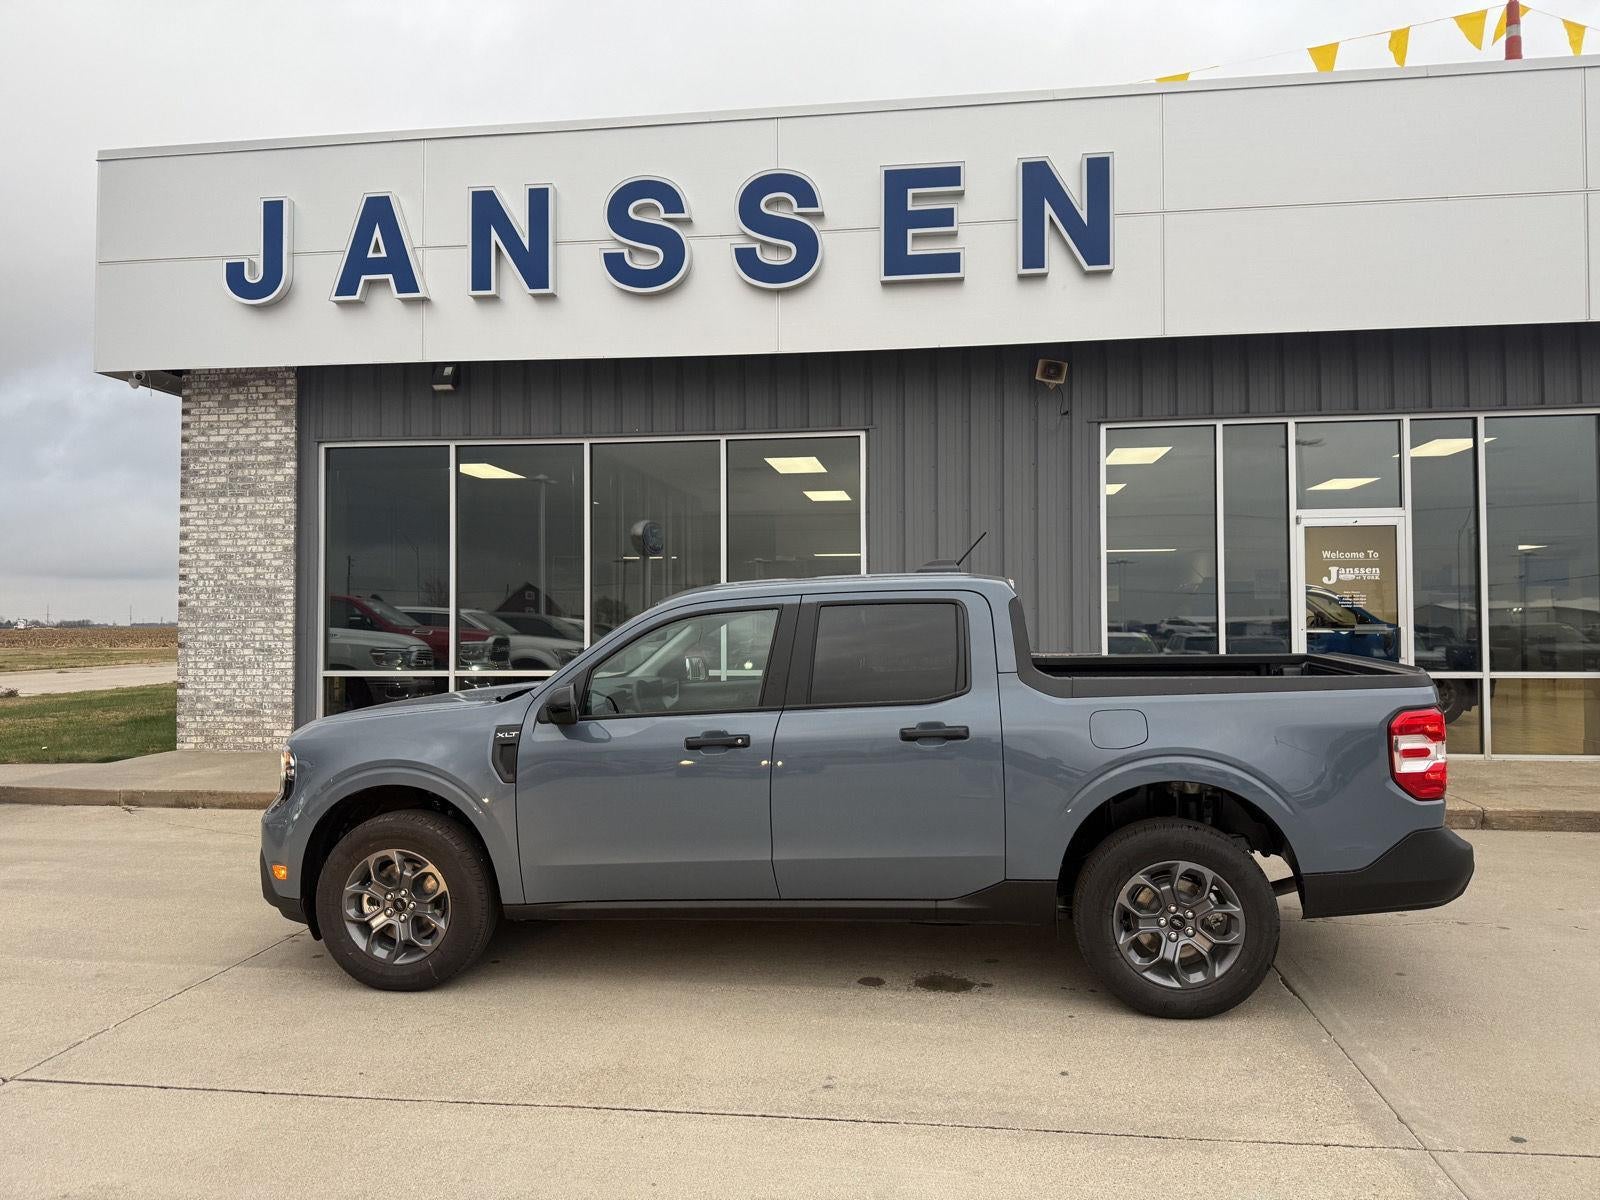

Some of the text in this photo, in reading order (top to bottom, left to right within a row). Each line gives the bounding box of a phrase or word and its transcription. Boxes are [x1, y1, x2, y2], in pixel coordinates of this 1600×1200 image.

[223, 151, 1115, 307] JANSSEN
[1322, 550, 1379, 559] Welcome To
[1322, 566, 1380, 585] Janssen
